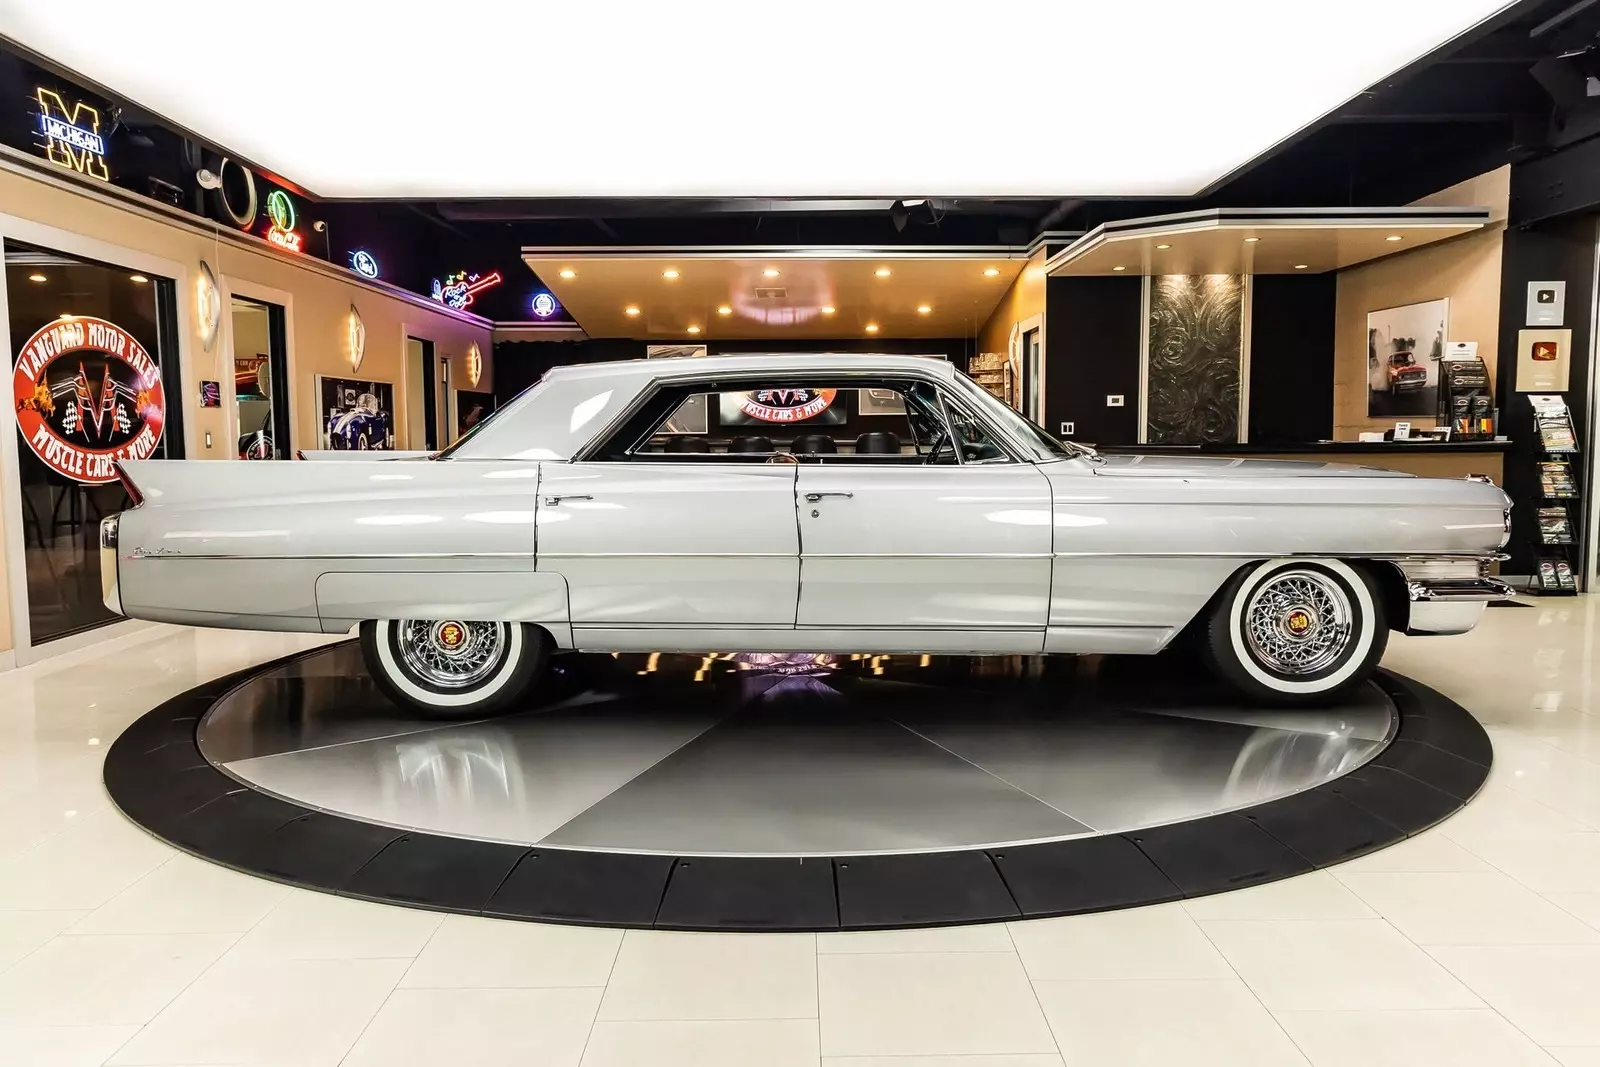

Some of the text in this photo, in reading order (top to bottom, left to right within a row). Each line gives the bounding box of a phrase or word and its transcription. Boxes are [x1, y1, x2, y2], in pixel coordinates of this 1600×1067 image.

[47, 119, 99, 151] MICHIGAN
[445, 283, 466, 298] Rock
[18, 322, 159, 389] VANGUARD MOTOR SALES
[772, 409, 794, 421] CARS
[803, 397, 827, 417] MORE
[32, 423, 84, 475] MUSCLE
[86, 452, 116, 478] CARS
[128, 424, 156, 461] MORE
